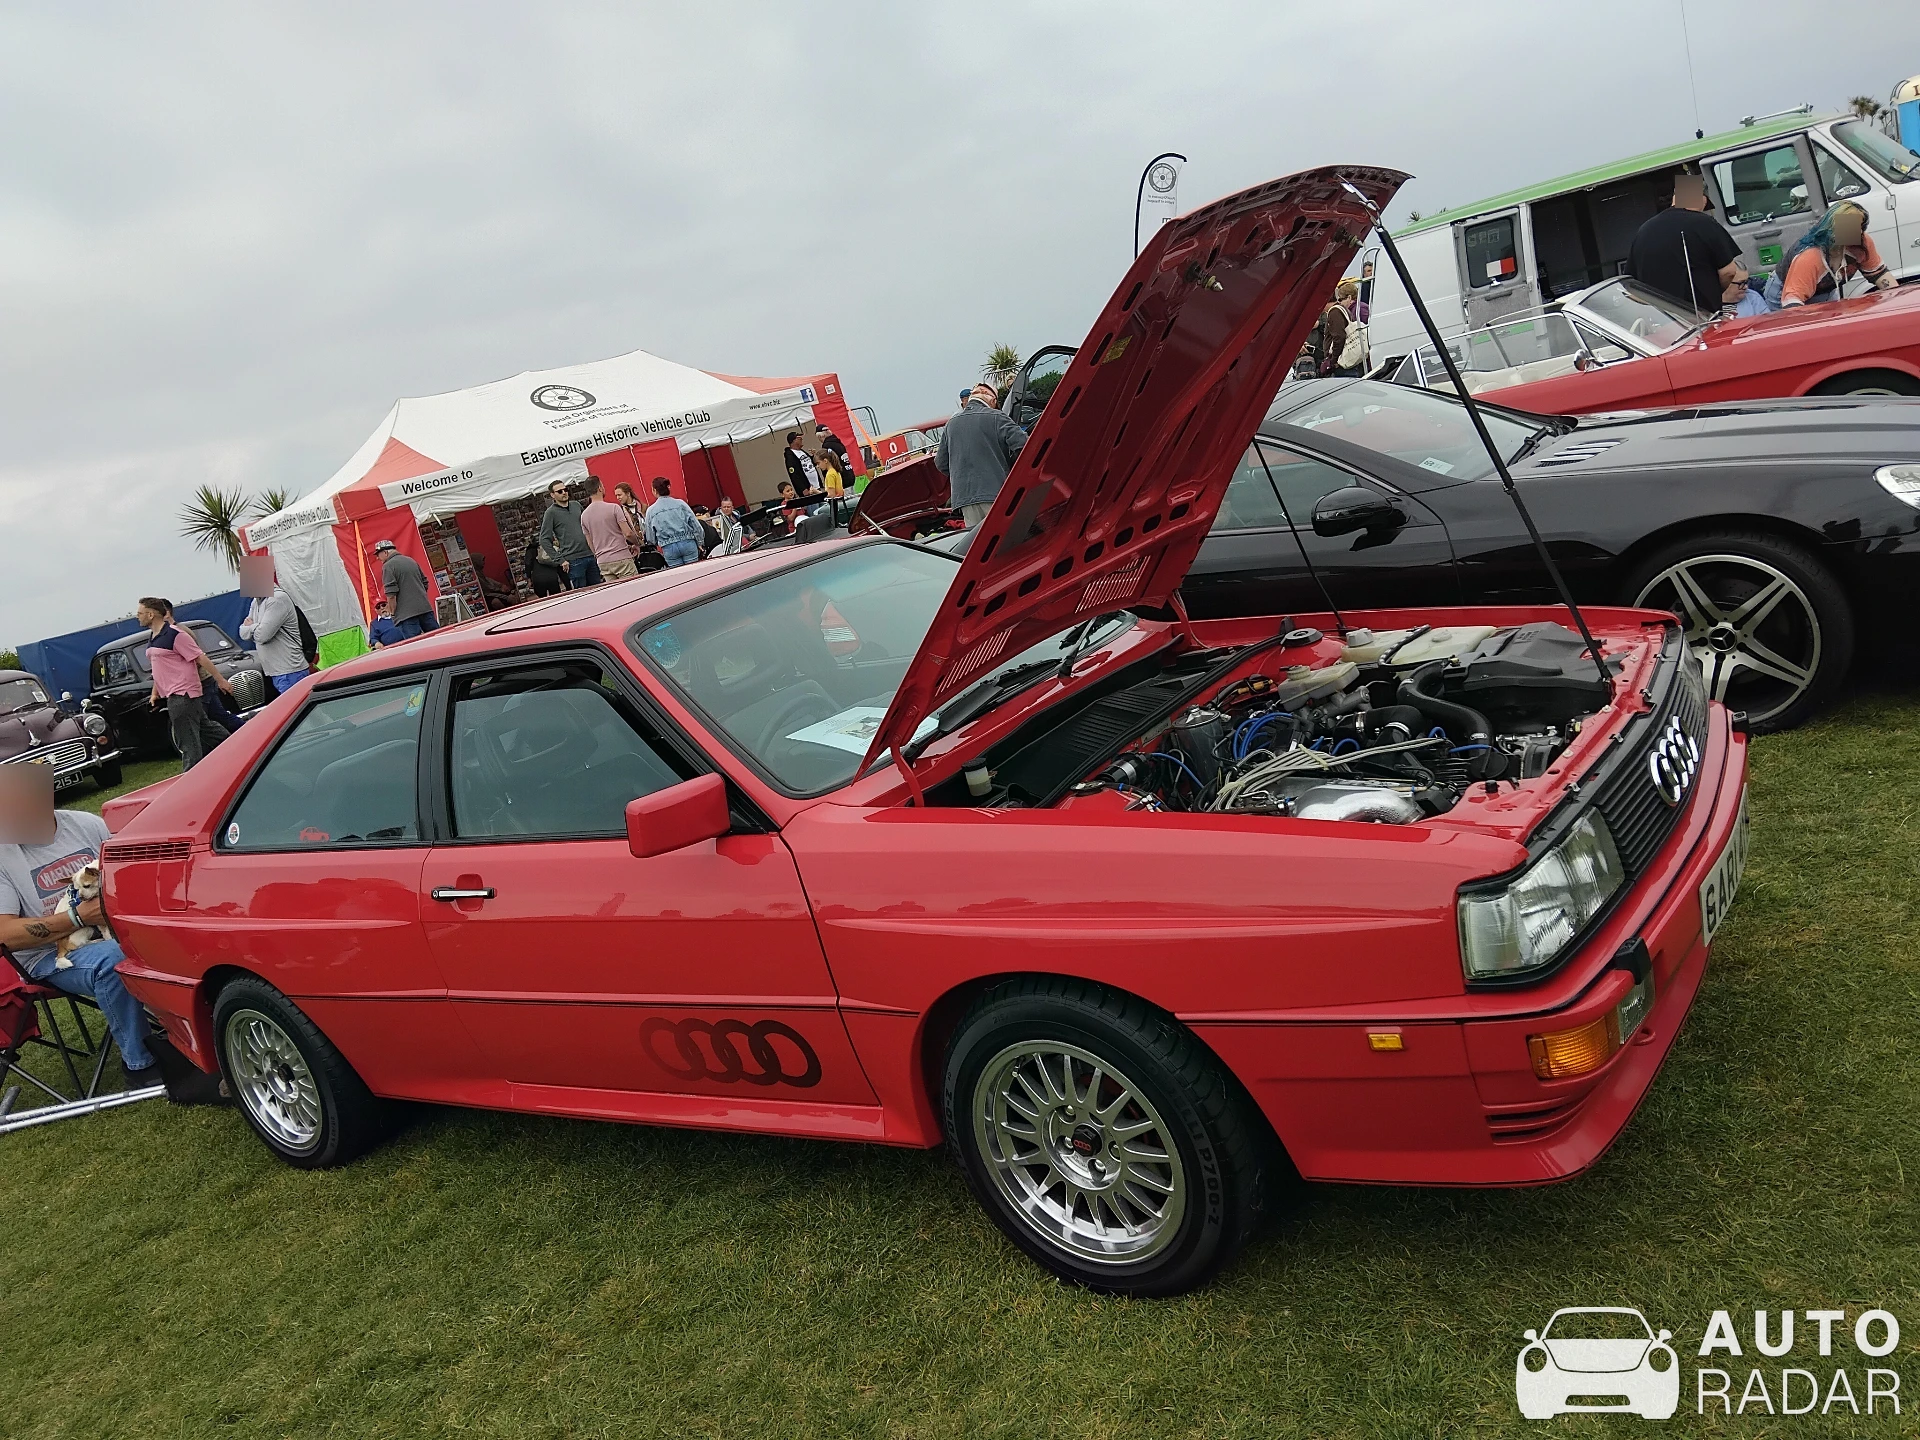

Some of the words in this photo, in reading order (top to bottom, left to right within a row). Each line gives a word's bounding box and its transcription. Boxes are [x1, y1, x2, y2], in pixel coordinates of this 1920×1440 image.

[543, 415, 571, 426] Proud
[520, 438, 593, 466] Eastbourne
[593, 425, 640, 447] Historic
[641, 415, 683, 434] Vehicle
[684, 410, 711, 425] Club
[401, 474, 459, 495] Welcome
[461, 469, 473, 480] to
[250, 524, 278, 543] Eastbourne
[277, 514, 298, 533] Historic
[296, 508, 317, 525] Vehicle
[316, 505, 331, 521] Club
[54, 773, 80, 790] 215J
